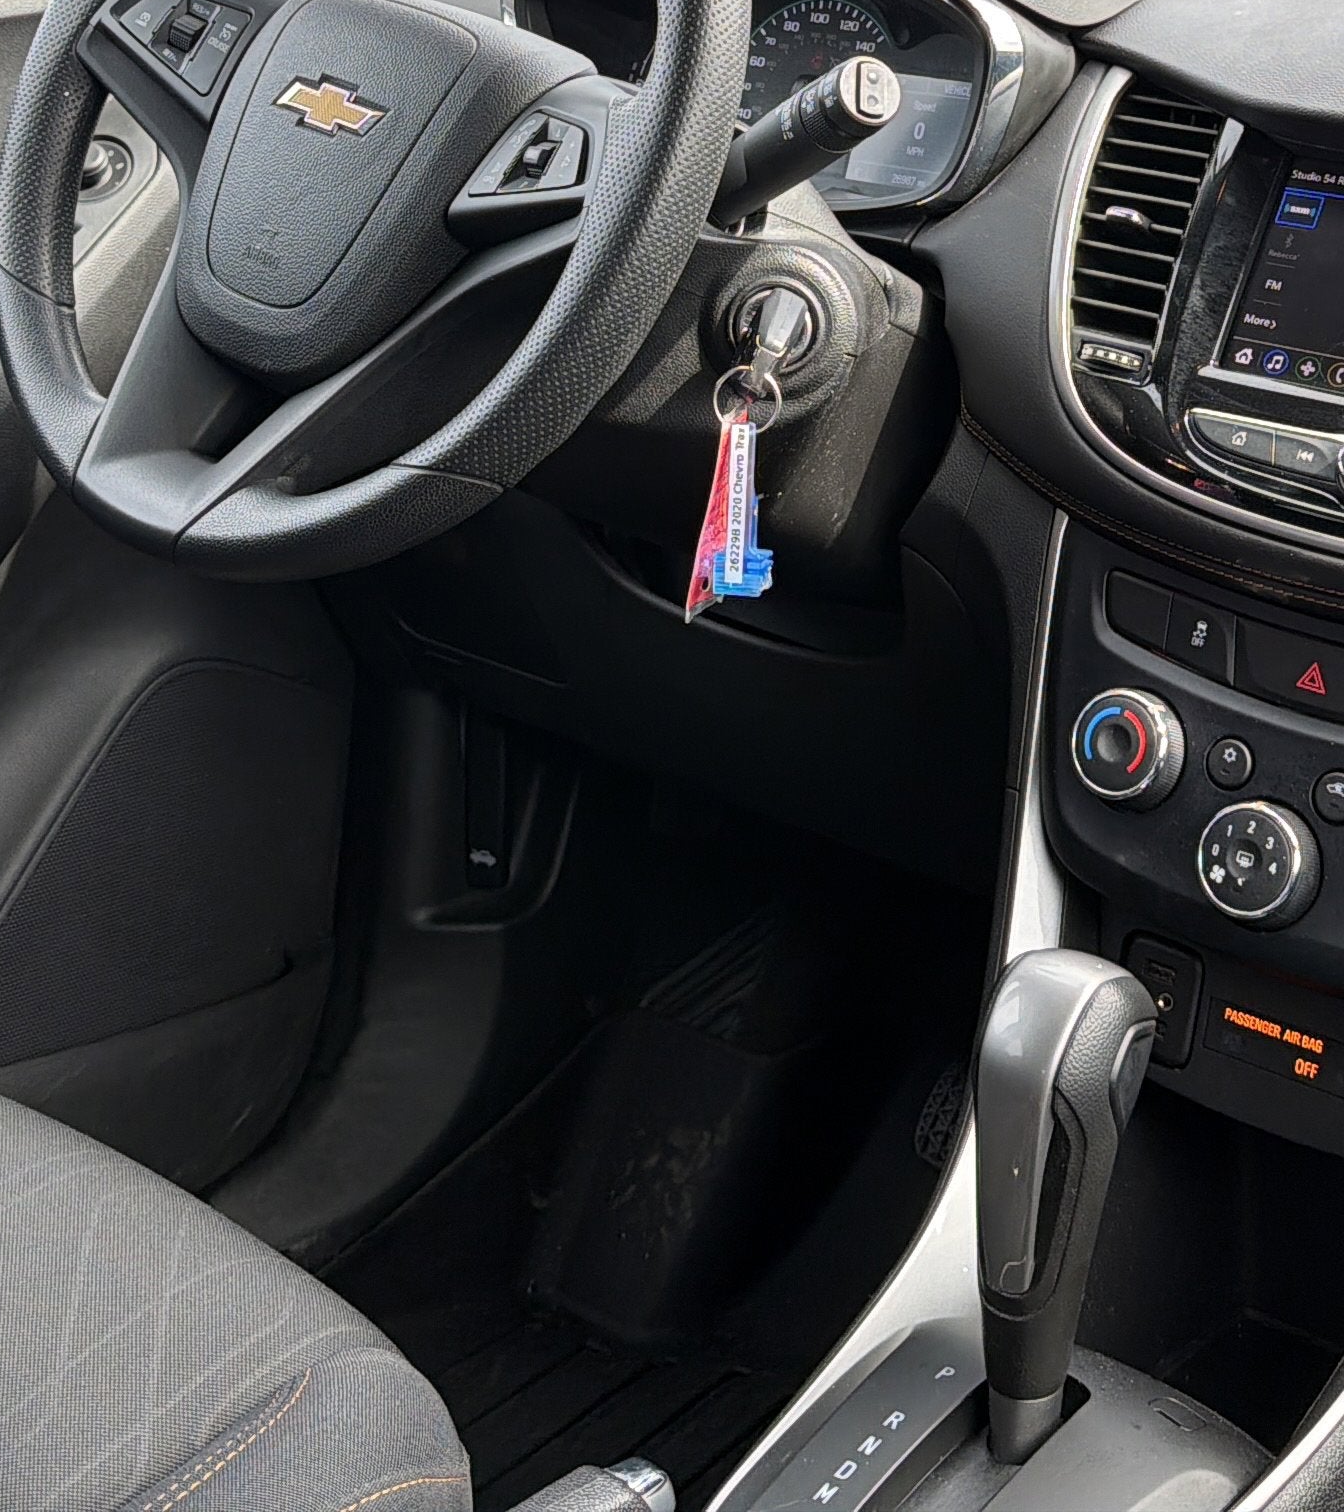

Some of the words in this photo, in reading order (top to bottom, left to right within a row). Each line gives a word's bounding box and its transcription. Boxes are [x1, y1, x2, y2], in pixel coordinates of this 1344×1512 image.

[810, 13, 829, 24] 100
[839, 20, 859, 31] 120
[783, 21, 800, 32] 80
[765, 37, 776, 46] 70
[855, 41, 876, 52] 140
[749, 56, 765, 67] 60
[913, 122, 925, 140] 0
[906, 146, 924, 157] MPH
[1291, 169, 1321, 183] Studio
[1322, 174, 1337, 185] 54
[1264, 279, 1283, 292] FM
[1243, 313, 1270, 327] More
[733, 454, 745, 495] Chevro
[731, 497, 743, 525] 2020
[1190, 634, 1207, 649] OFF
[1226, 824, 1233, 837] 1
[1247, 821, 1256, 834] 2
[1264, 836, 1274, 849] 3
[1211, 844, 1220, 857] 0
[1268, 861, 1277, 875] 4
[1223, 1007, 1281, 1039] PASSENGER
[1282, 1029, 1302, 1046] AIR
[1302, 1034, 1324, 1054] BAG
[1294, 1057, 1320, 1080] OFF
[934, 1366, 955, 1380] P
[882, 1411, 905, 1430] R
[857, 1435, 882, 1455] N
[834, 1460, 857, 1480] D
[812, 1483, 839, 1504] M
